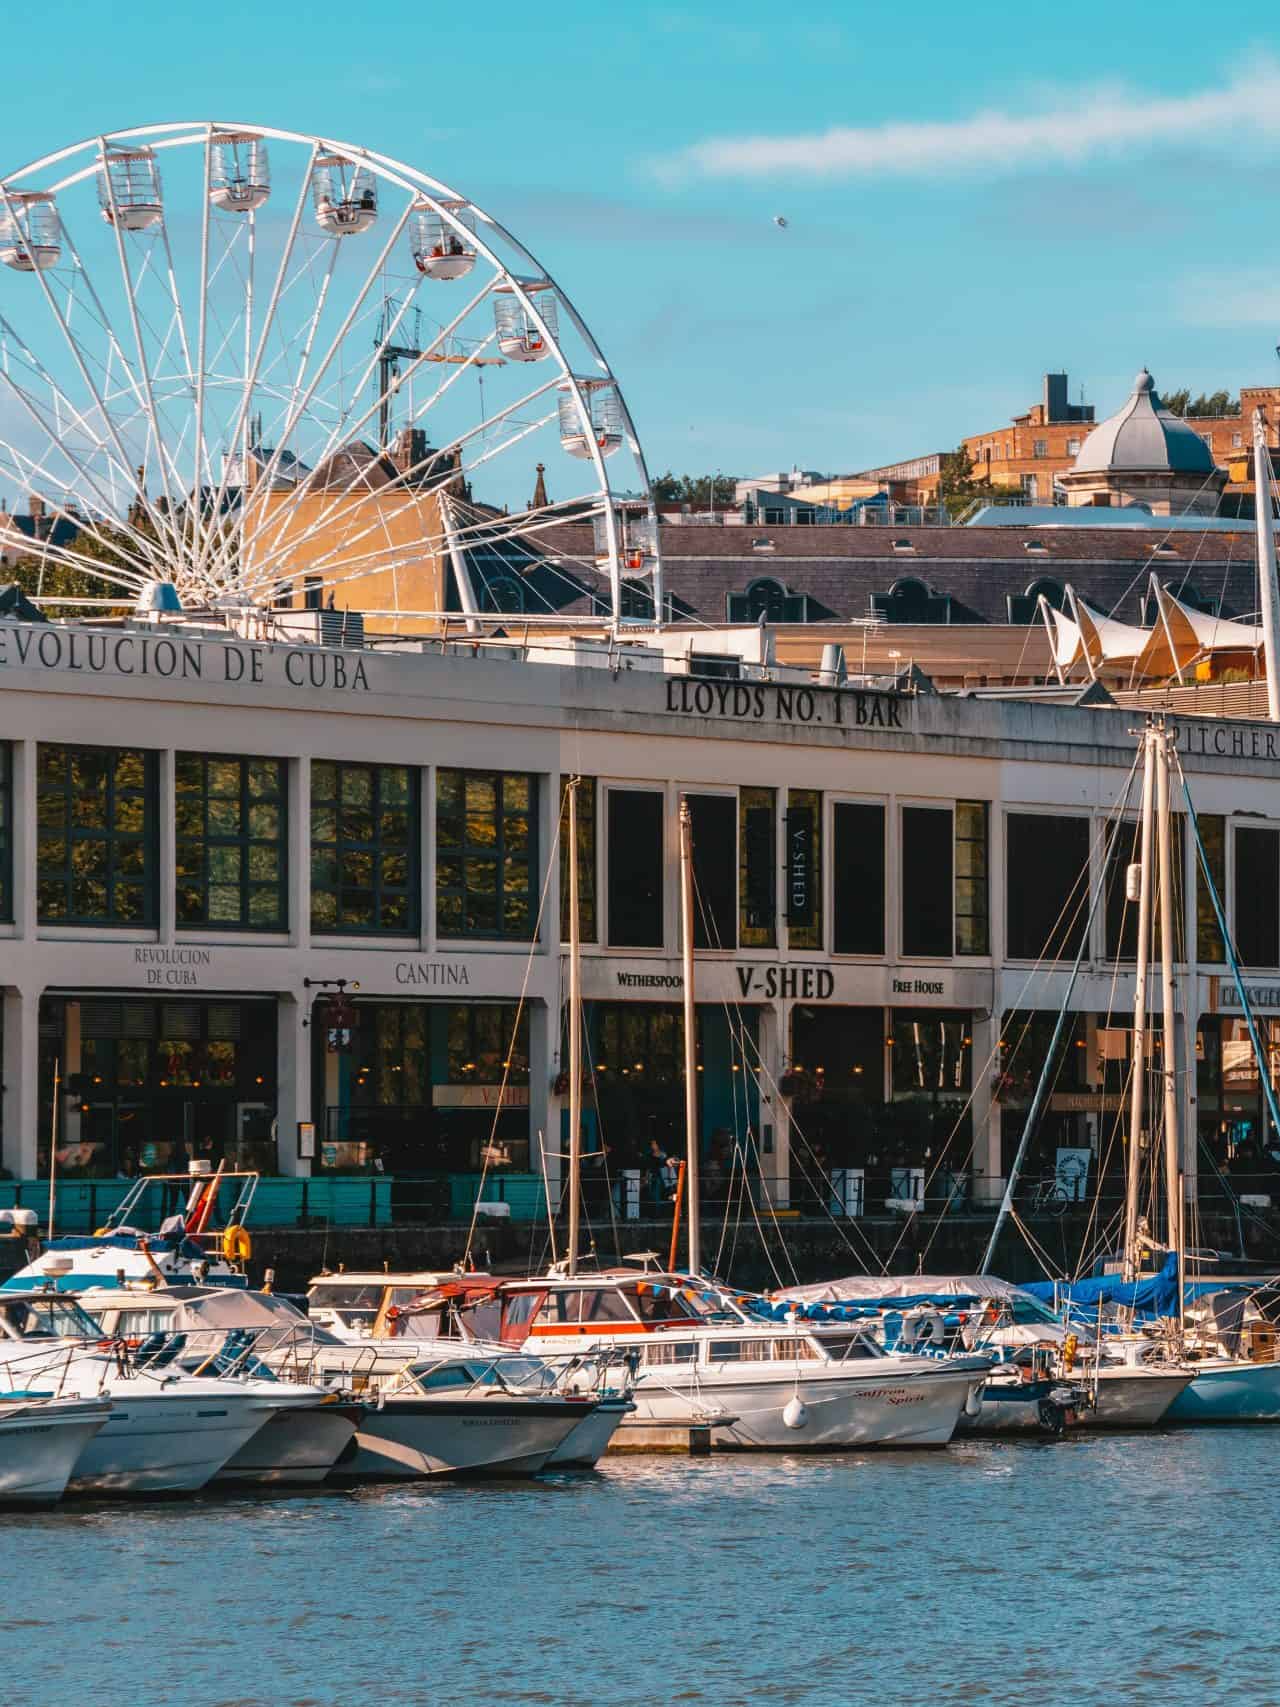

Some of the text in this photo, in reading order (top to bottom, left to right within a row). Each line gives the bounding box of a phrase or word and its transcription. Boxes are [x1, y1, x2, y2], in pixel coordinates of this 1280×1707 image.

[224, 646, 264, 682] DE
[285, 651, 370, 691] CUBA
[665, 679, 903, 728] LLOYDS NO. 1 BAR
[1172, 725, 1277, 758] PITCHER
[792, 829, 807, 907] V-SHED
[135, 948, 210, 965] REVOLUCION
[147, 968, 198, 985] DE CUBA
[395, 963, 470, 985] CANTINA
[735, 967, 835, 999] V-SHED
[892, 978, 945, 994] FREE HOUSE
